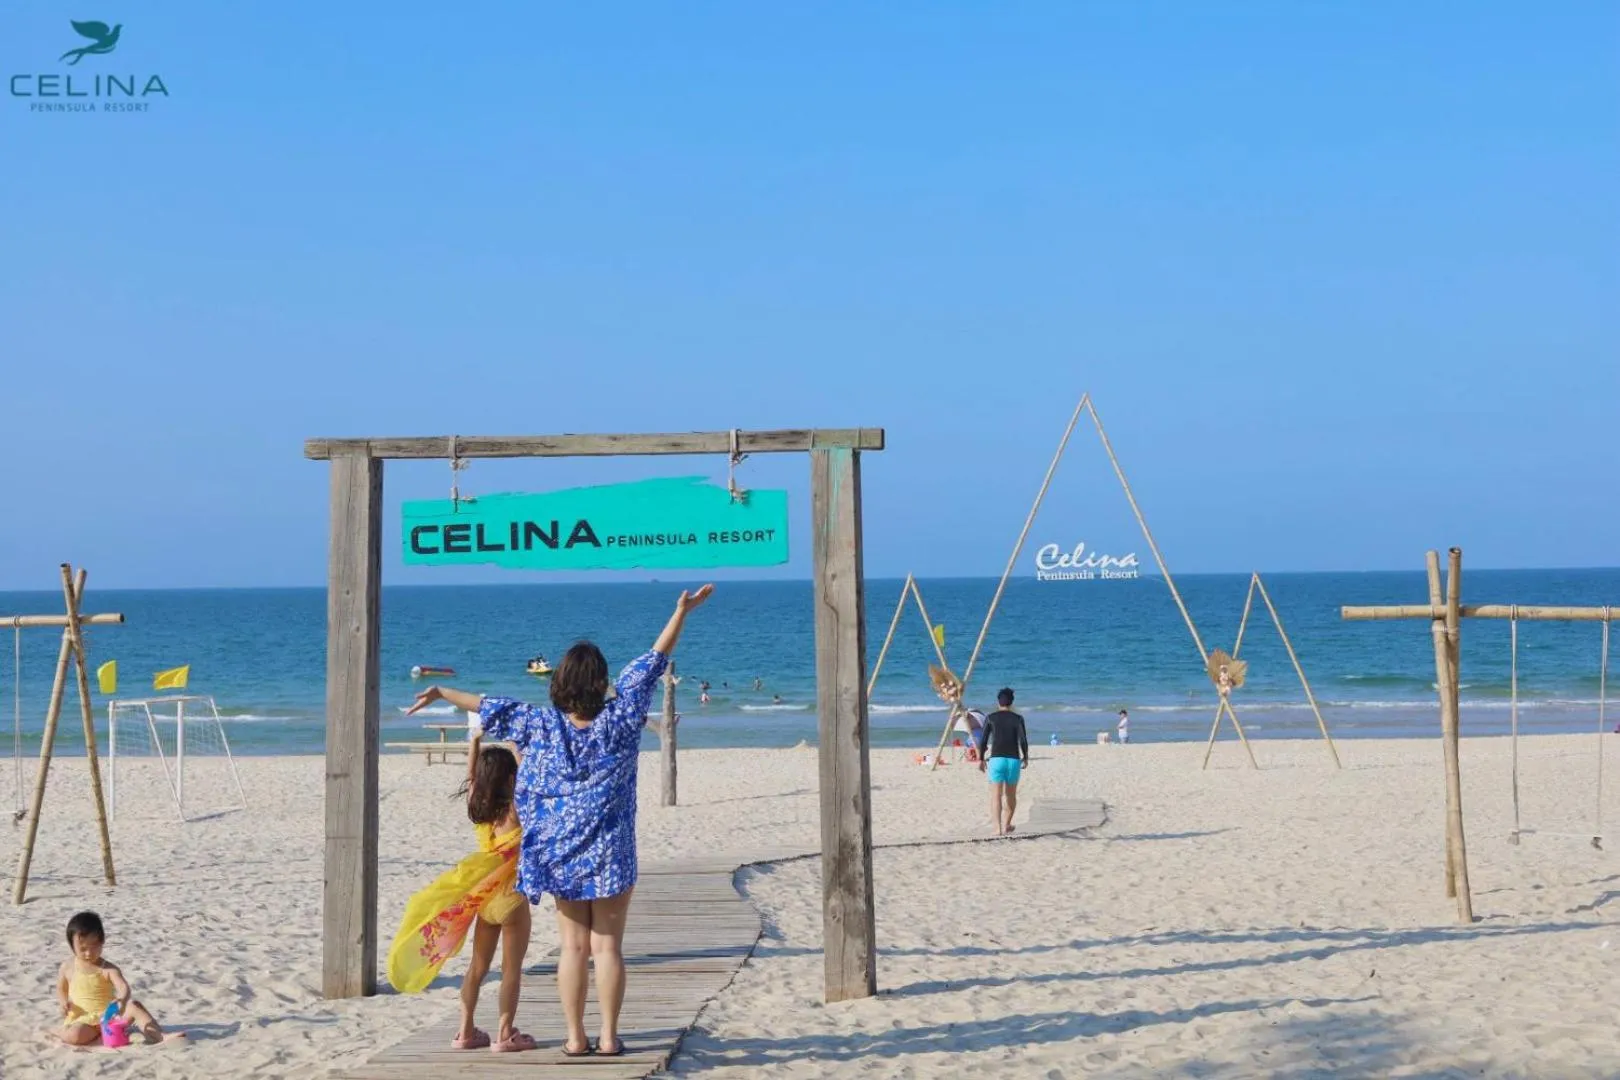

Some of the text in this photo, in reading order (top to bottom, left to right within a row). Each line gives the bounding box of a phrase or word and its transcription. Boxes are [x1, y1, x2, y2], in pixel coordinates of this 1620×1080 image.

[410, 518, 776, 555] CELINA PENINSULA RESORT
[1036, 542, 1140, 570] Celina
[1037, 568, 1139, 581] Peninsula Resort
